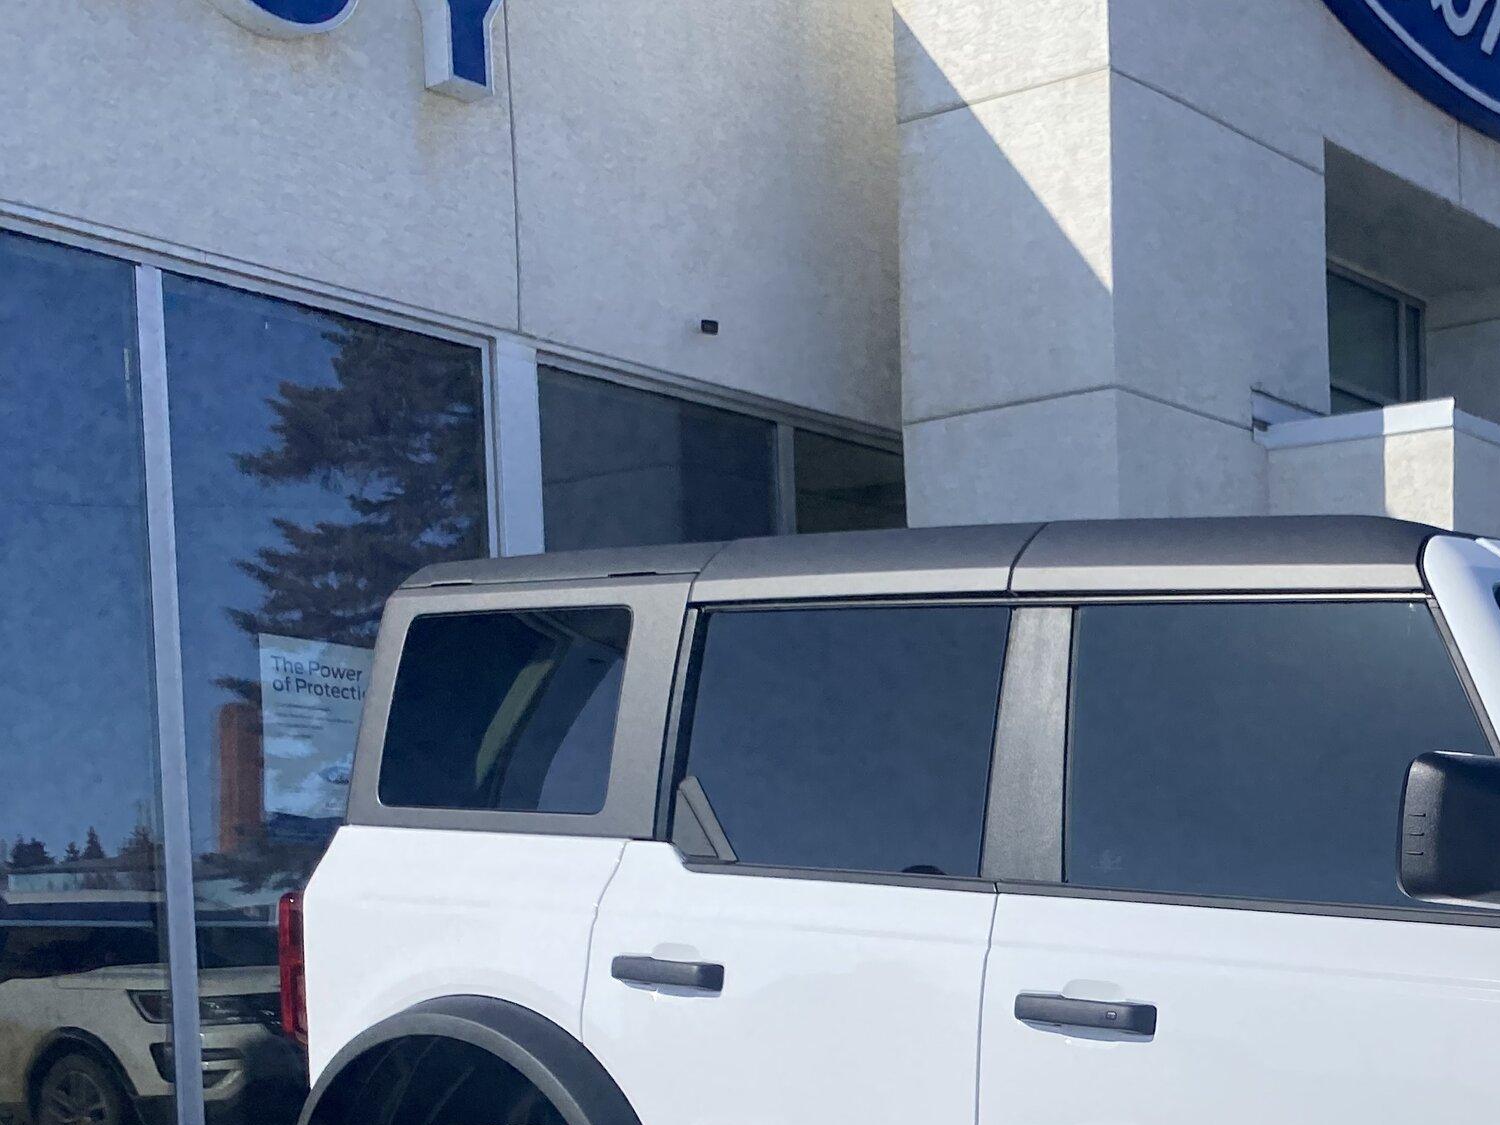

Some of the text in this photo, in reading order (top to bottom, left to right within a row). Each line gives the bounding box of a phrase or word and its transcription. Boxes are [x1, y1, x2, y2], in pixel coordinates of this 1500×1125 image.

[270, 655, 362, 682] The Power
[272, 676, 366, 702] of Protecti
